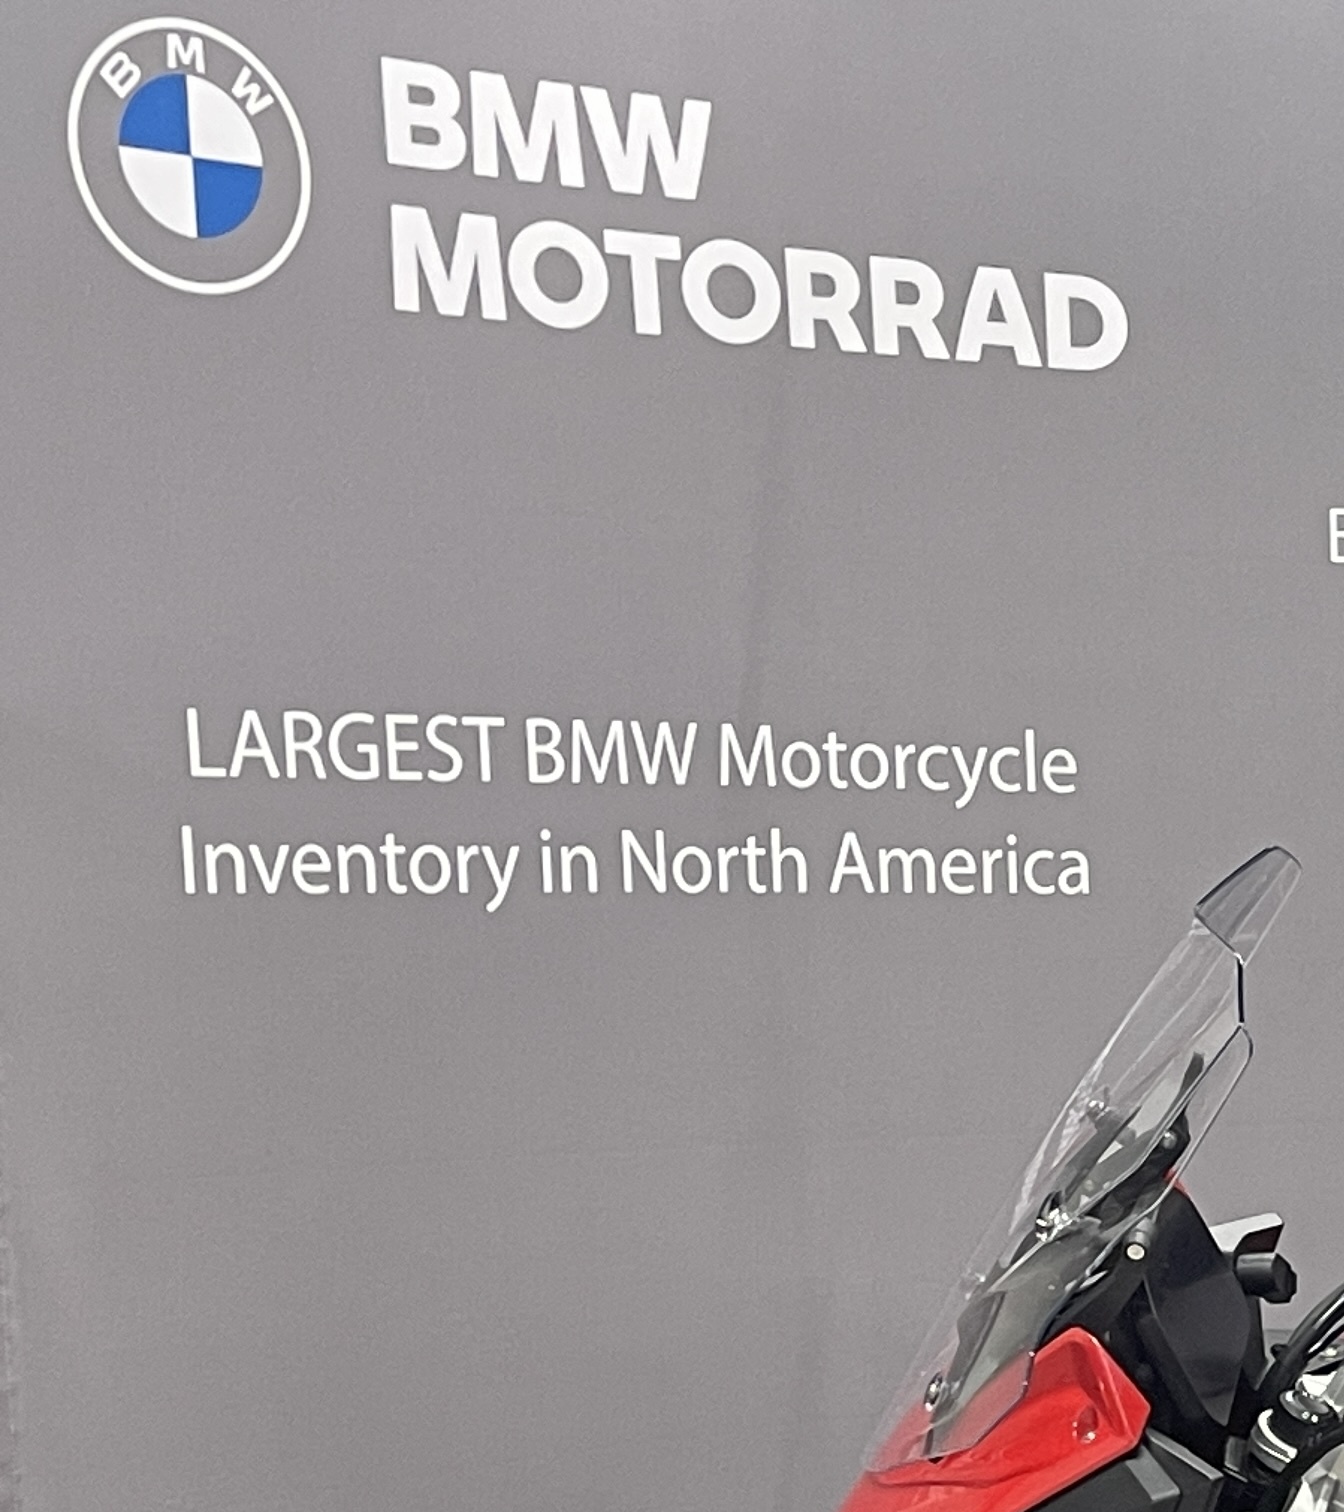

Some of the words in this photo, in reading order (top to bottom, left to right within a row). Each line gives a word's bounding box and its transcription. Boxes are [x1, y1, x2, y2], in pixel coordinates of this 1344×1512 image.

[98, 31, 276, 117] BMW
[379, 55, 713, 201] BMW
[389, 202, 1130, 372] MOTORRAD
[185, 706, 506, 784] LARGEST
[524, 716, 699, 787] BMW
[719, 722, 1079, 811] Motorcycle
[180, 823, 521, 914] Inventory
[539, 827, 600, 896] in
[620, 826, 809, 896] North
[828, 830, 1091, 896] America
